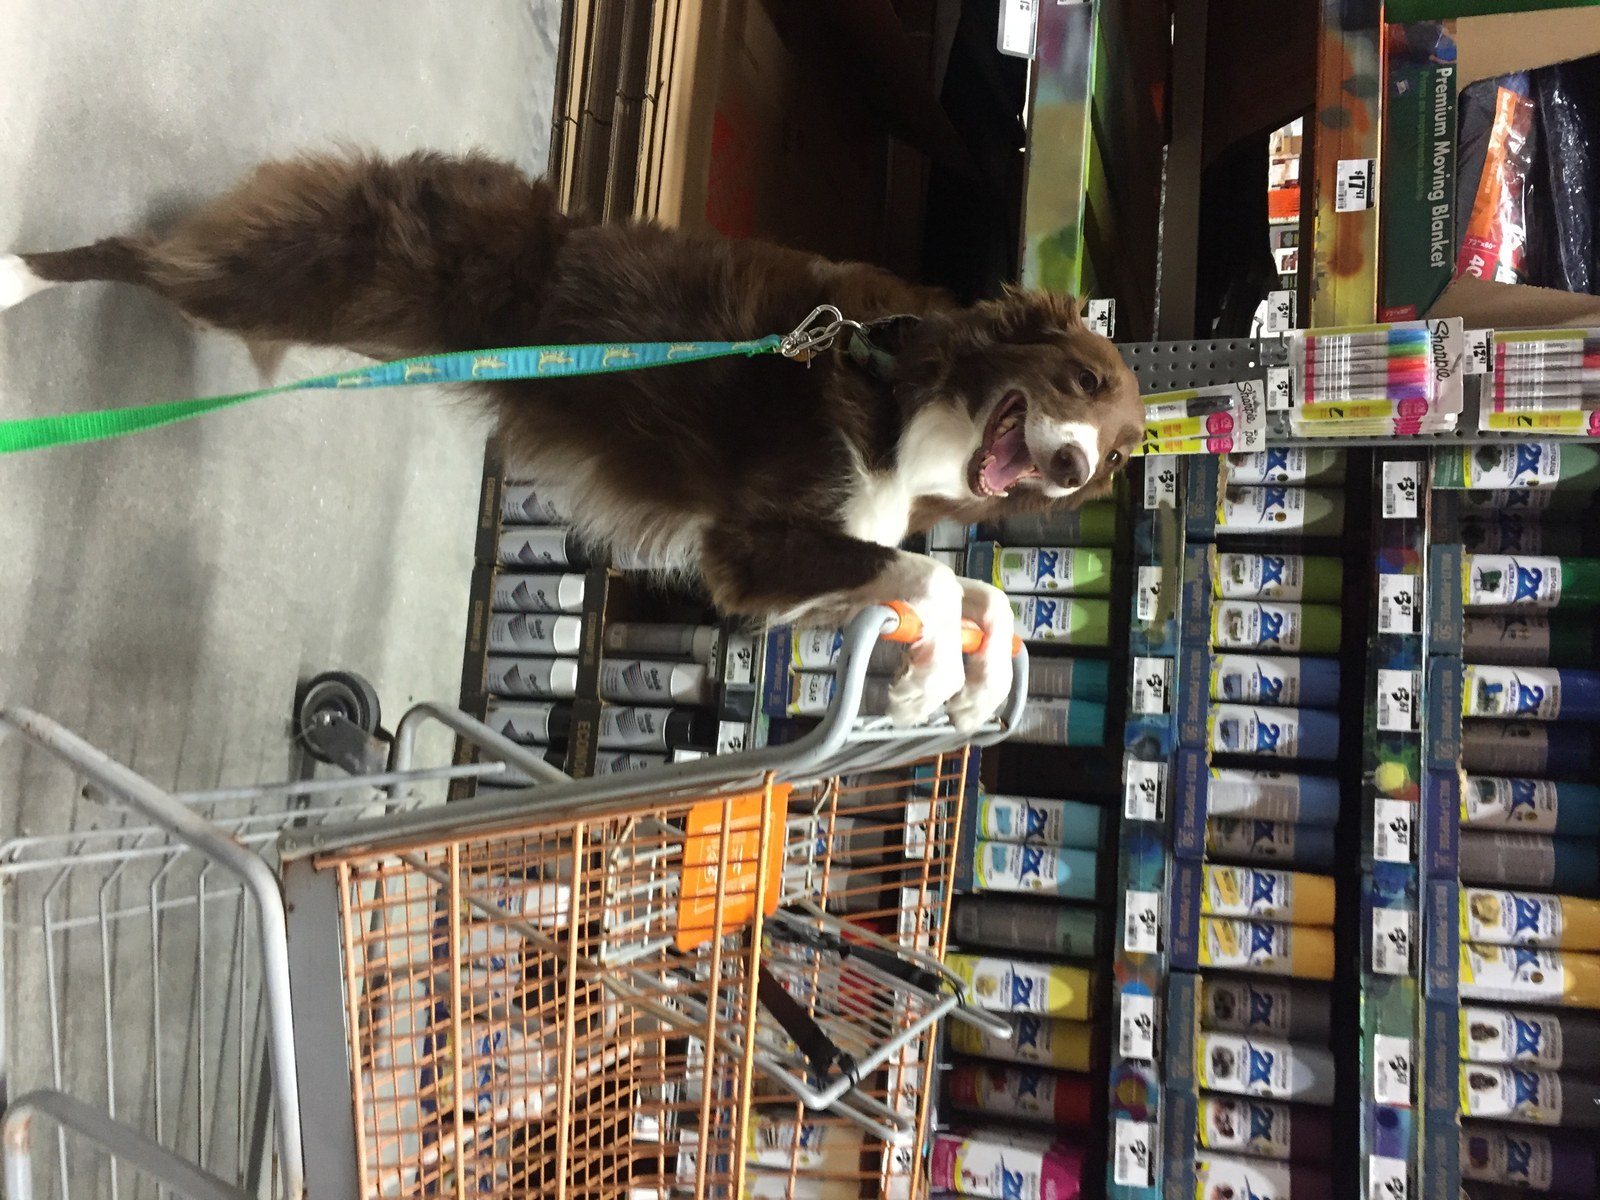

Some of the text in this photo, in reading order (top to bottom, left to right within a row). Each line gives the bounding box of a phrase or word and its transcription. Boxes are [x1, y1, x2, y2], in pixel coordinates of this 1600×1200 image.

[1428, 67, 1452, 267] Premium Moving Blanket
[1426, 320, 1450, 382] Sharpie
[1236, 382, 1257, 424] Sharpie
[1517, 444, 1542, 475] 2X
[1037, 550, 1058, 579] 2X
[1262, 556, 1284, 586] 2X
[1517, 567, 1542, 600] 2X
[1034, 600, 1056, 630] 2X
[1260, 612, 1283, 644] 2X
[808, 674, 820, 702] CLEAR
[574, 720, 592, 780] ECONOM
[1510, 780, 1536, 809] 2X
[1027, 808, 1048, 840] 2X
[1022, 848, 1044, 878] 2X
[1252, 872, 1276, 904] 2X
[1516, 897, 1542, 934] 2X
[1252, 923, 1274, 956] 2X
[1012, 976, 1034, 1008] 2X
[1251, 992, 1274, 1026] 2X
[1018, 1018, 1041, 1048] 2X
[1516, 1016, 1542, 1057] 2X
[1250, 1050, 1274, 1086] 2X
[1515, 1070, 1540, 1106] 2X
[1250, 1106, 1274, 1142] 2X
[1507, 1138, 1532, 1177] 2X
